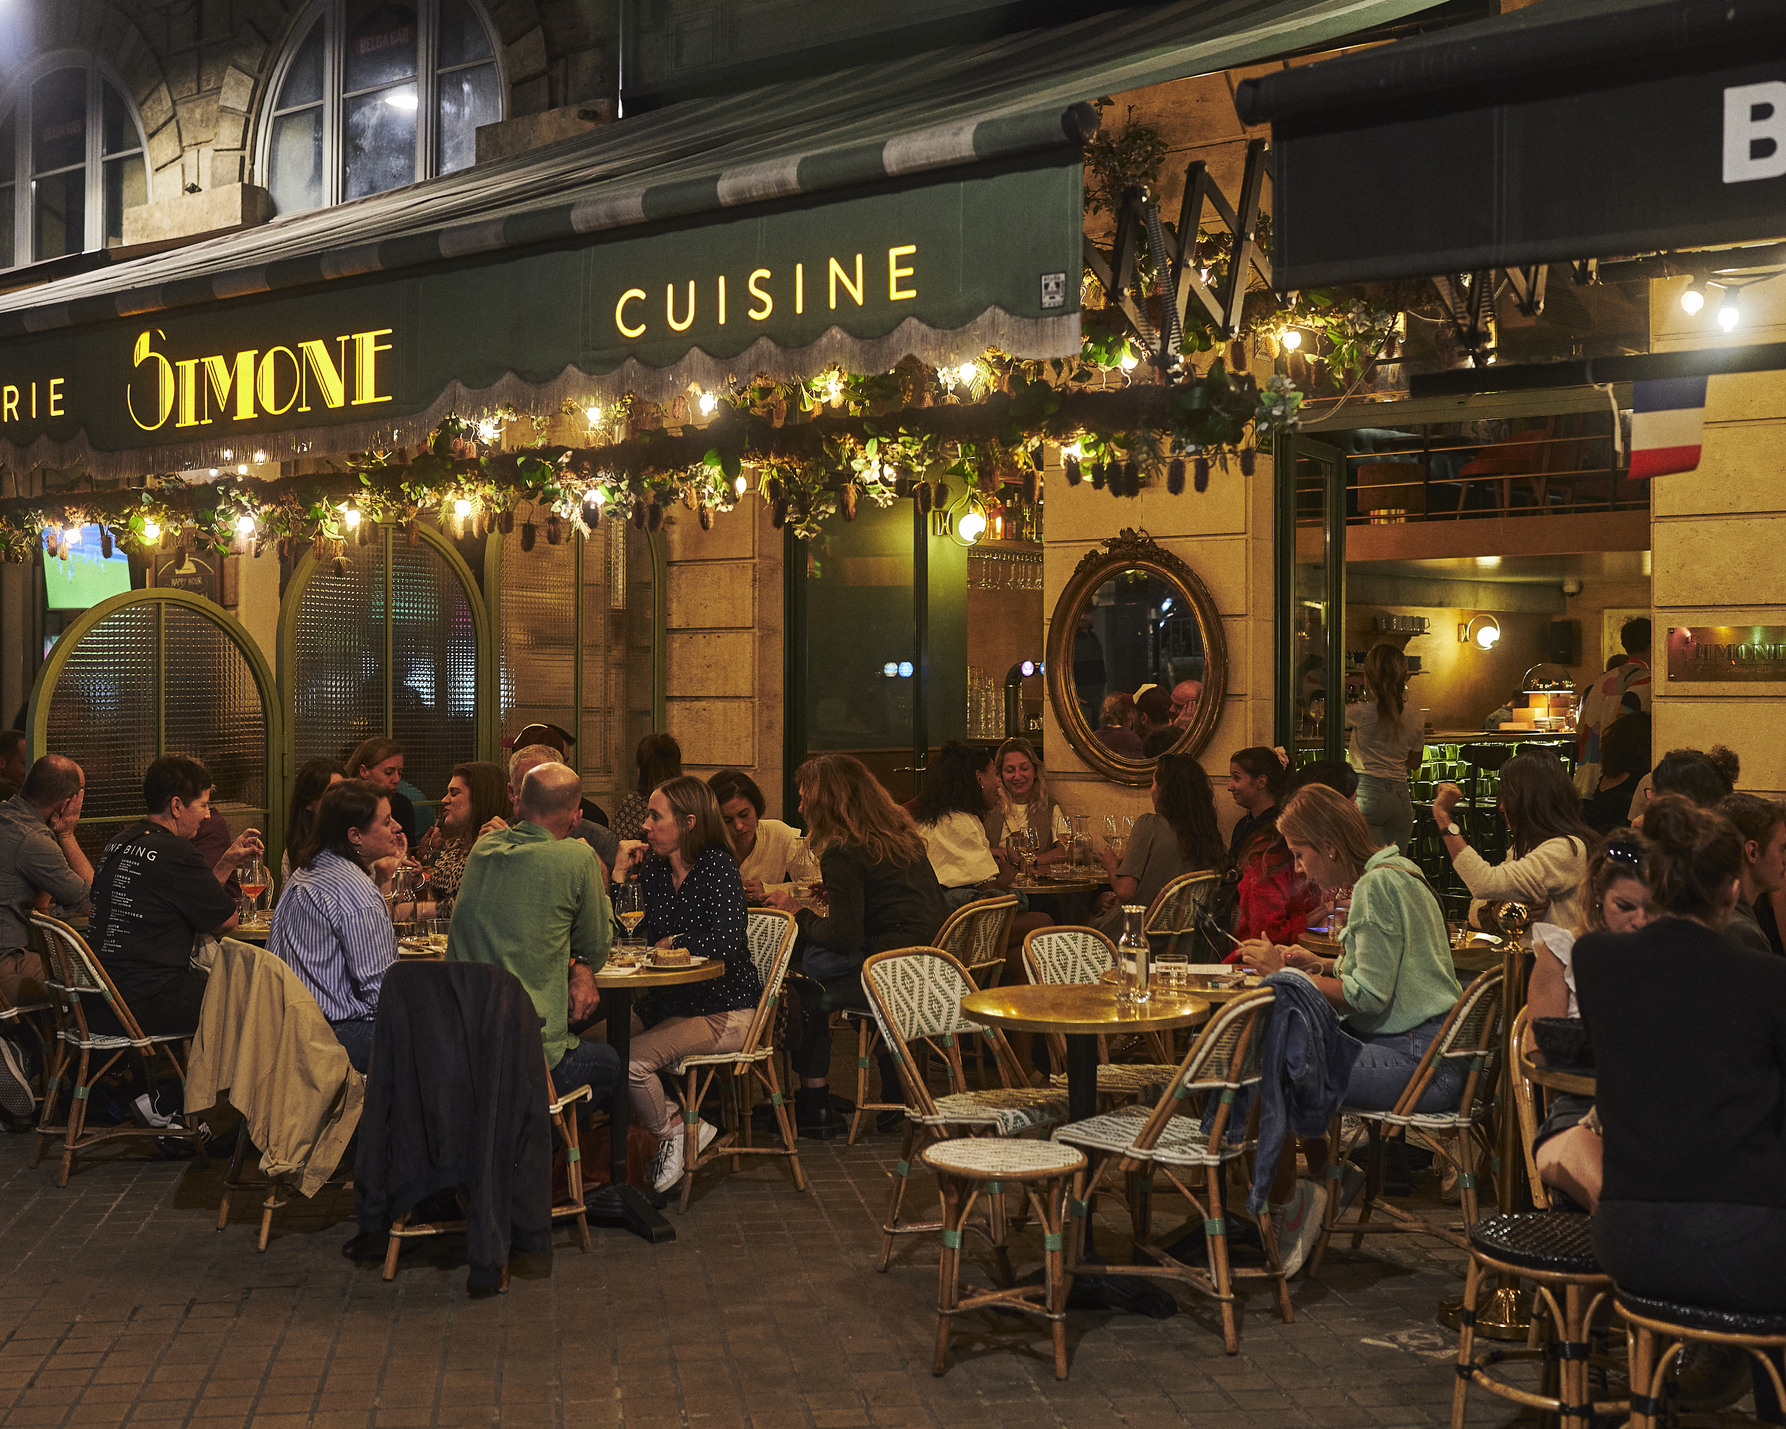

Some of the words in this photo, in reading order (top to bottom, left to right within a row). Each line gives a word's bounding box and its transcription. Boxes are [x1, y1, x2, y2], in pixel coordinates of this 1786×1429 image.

[3, 377, 65, 424] RIE
[127, 327, 393, 431] SIMONE
[615, 244, 917, 338] CUISINE
